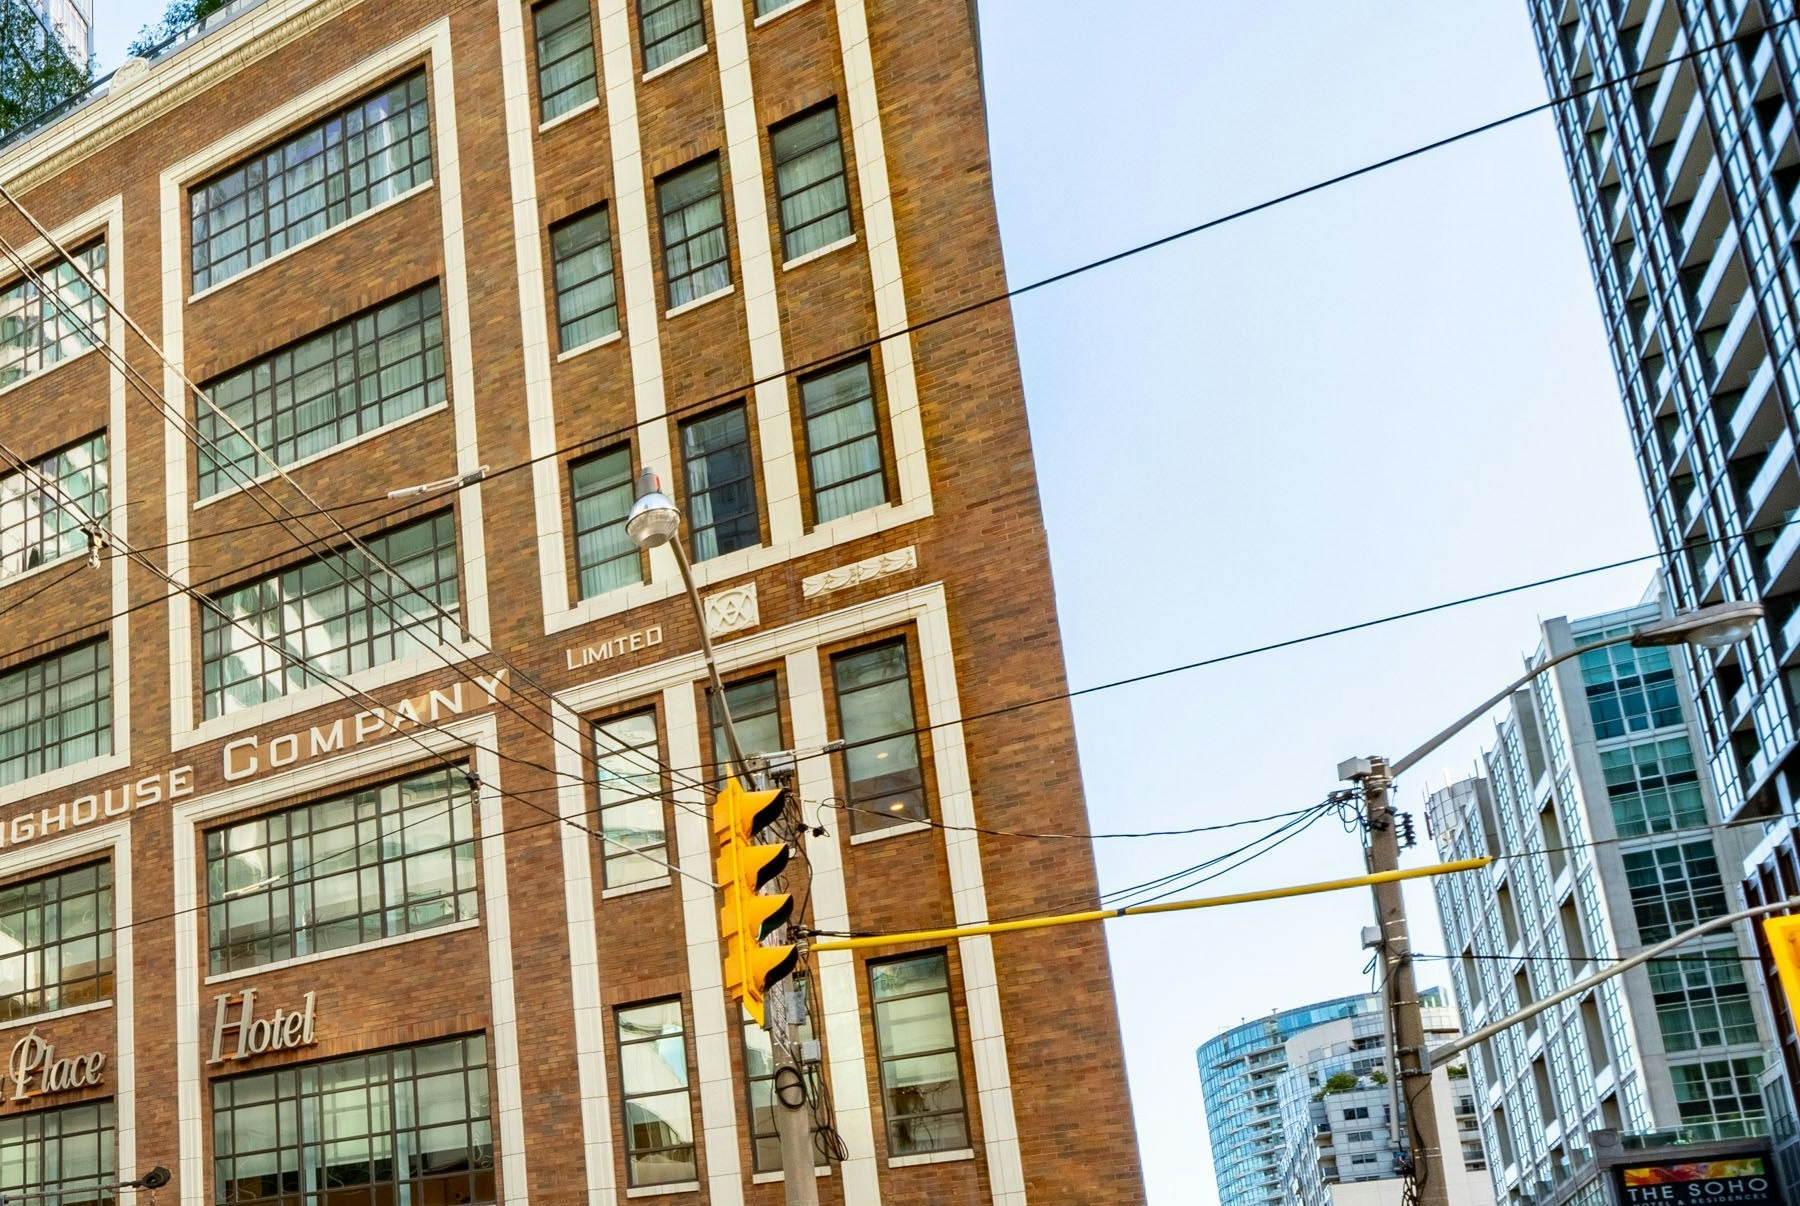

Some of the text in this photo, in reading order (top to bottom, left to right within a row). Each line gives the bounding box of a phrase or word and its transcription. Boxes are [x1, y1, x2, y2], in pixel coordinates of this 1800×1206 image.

[224, 669, 510, 781] COMPANY
[567, 624, 663, 671] LIMITED
[8, 1028, 106, 1101] Place
[207, 988, 317, 1065] Hotel
[1627, 1178, 1768, 1202] THE SOHO
[1691, 1193, 1768, 1205] RESIDENCES
